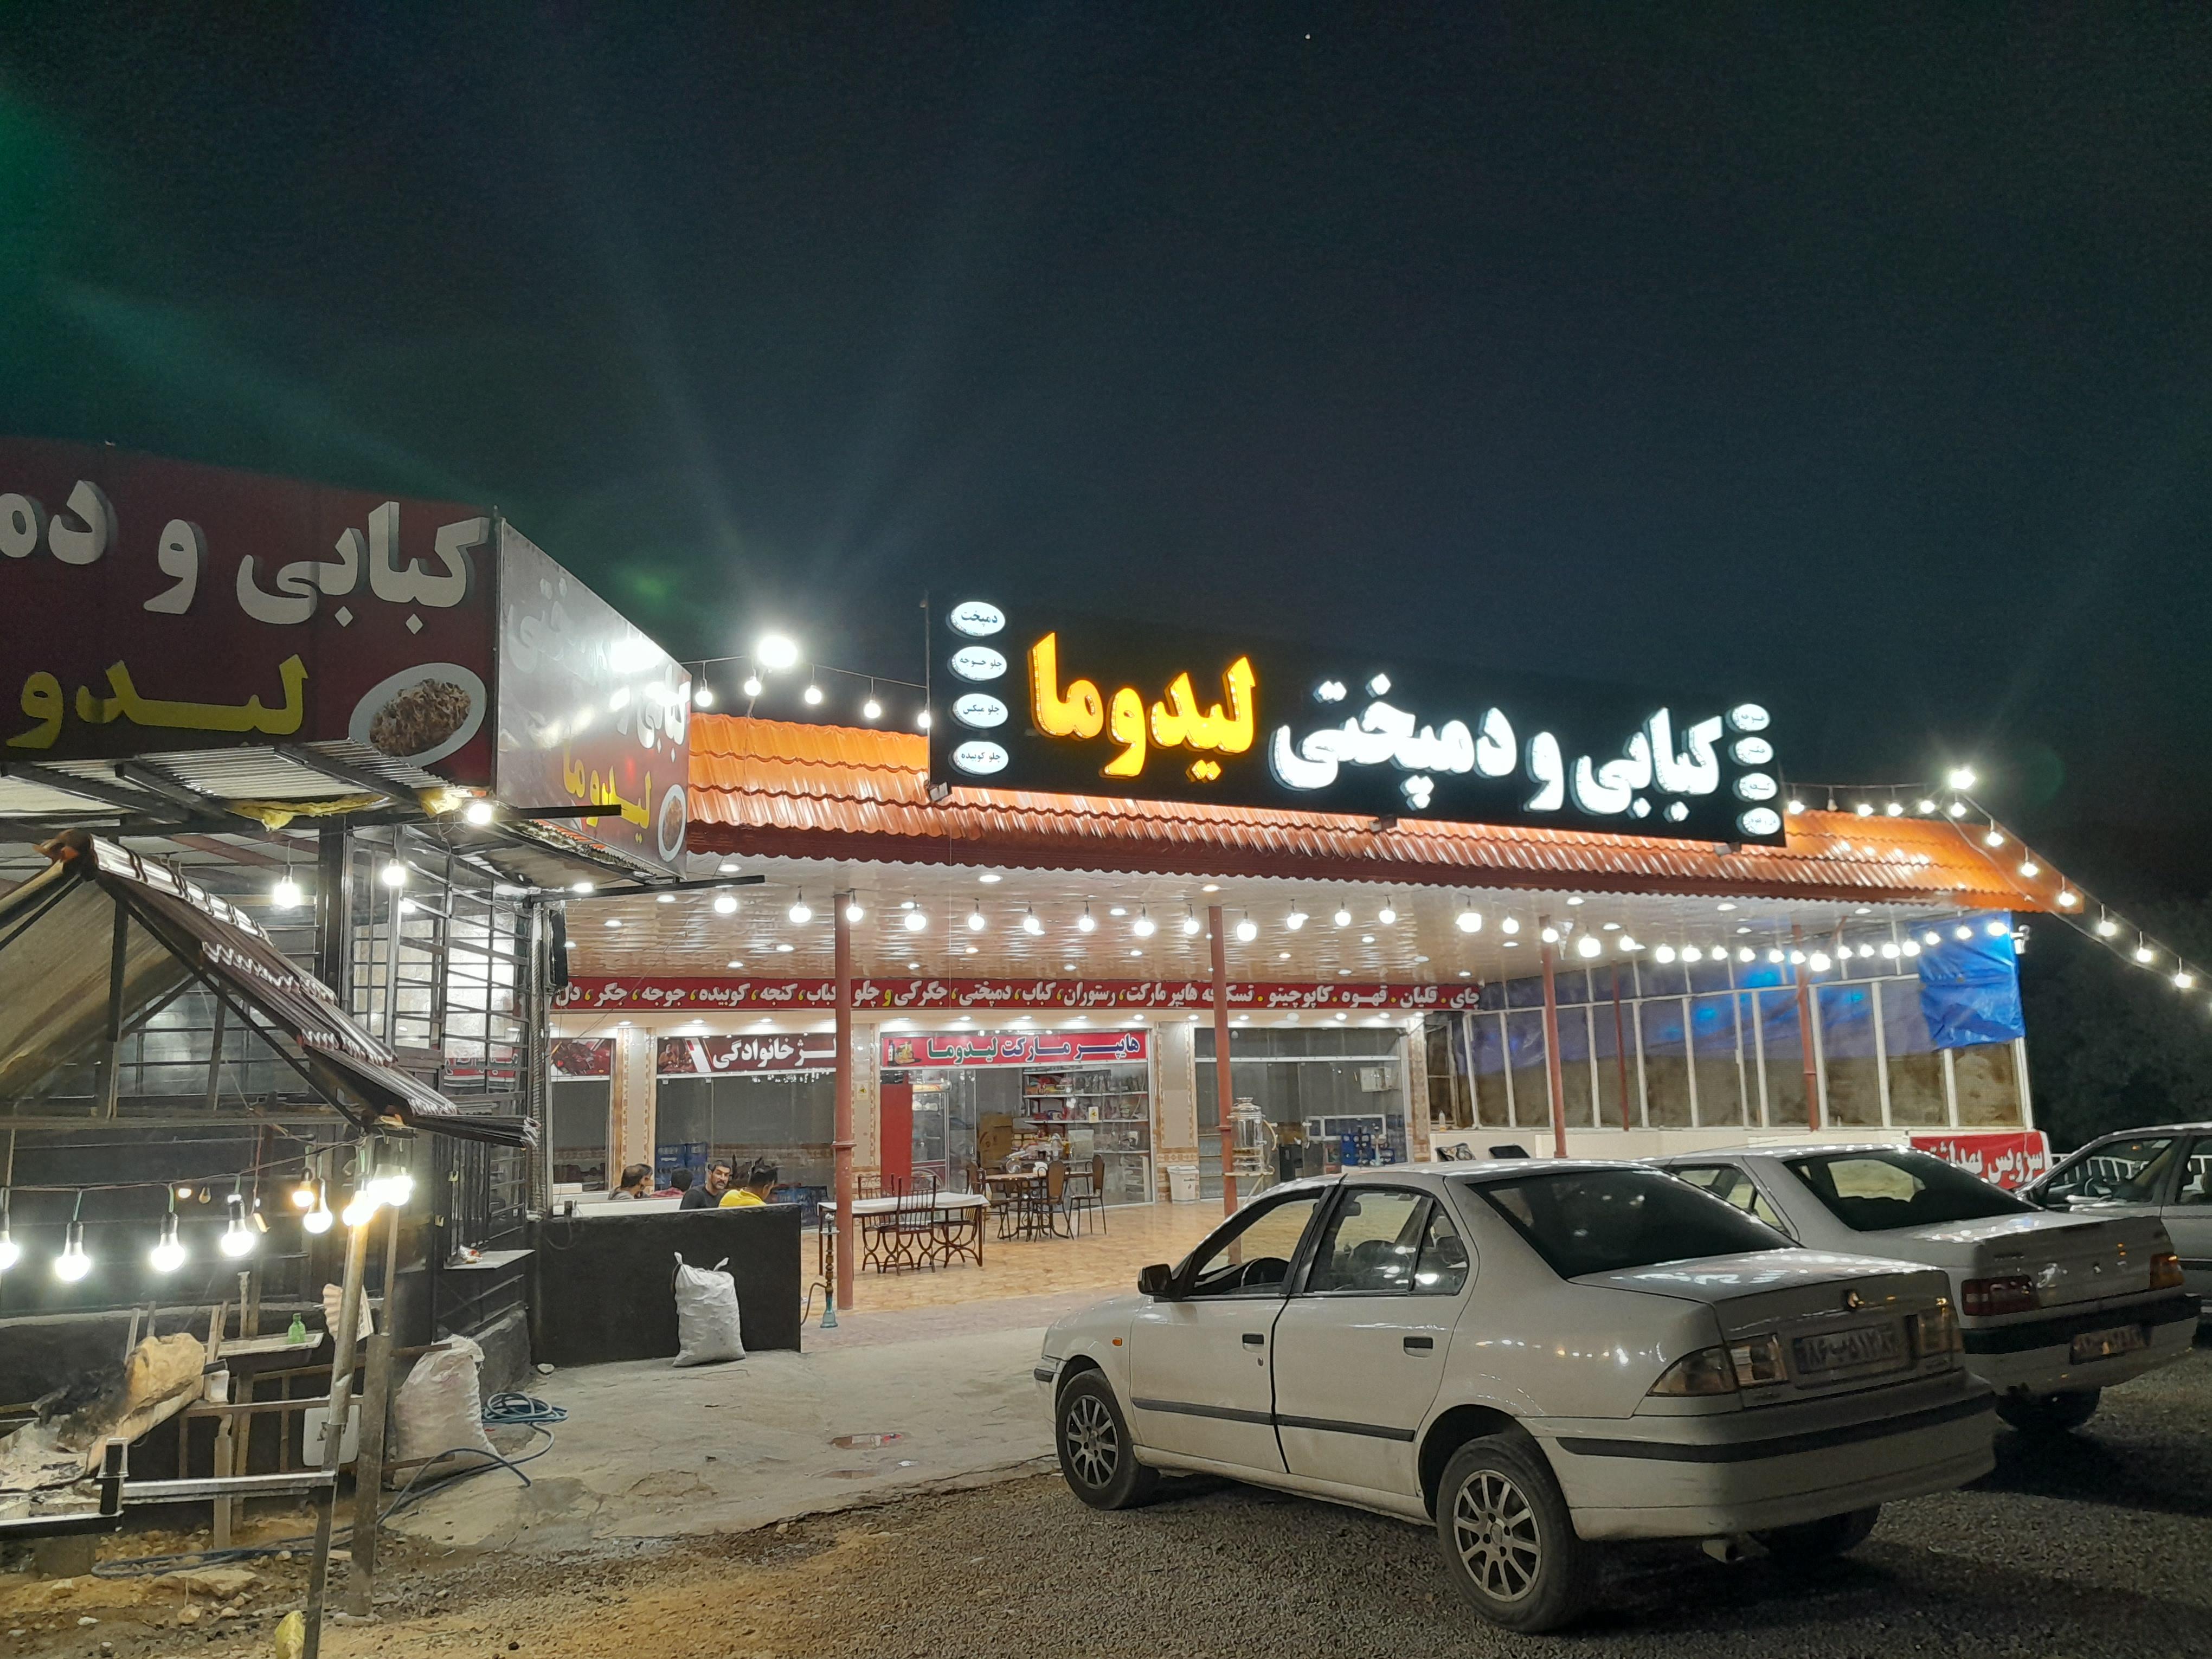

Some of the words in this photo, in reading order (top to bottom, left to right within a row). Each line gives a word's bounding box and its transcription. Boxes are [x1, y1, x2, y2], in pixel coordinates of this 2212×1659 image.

[144, 519, 206, 614] و
[236, 501, 490, 634] کبابی
[1028, 631, 1256, 781] لیدوما
[1269, 673, 1516, 811] دمپختی
[1523, 730, 1564, 812] و
[1571, 707, 1724, 822] کبابی
[852, 980, 880, 1007] چلو
[882, 989, 892, 1006] و
[1341, 985, 1388, 1007] قهوه
[1400, 986, 1438, 1008] قلیان
[713, 1037, 794, 1069] خانوادگی
[927, 1037, 998, 1064] لیدوما
[1001, 1036, 1071, 1062] مارکت
[1988, 1148, 2043, 1184] سرویس
